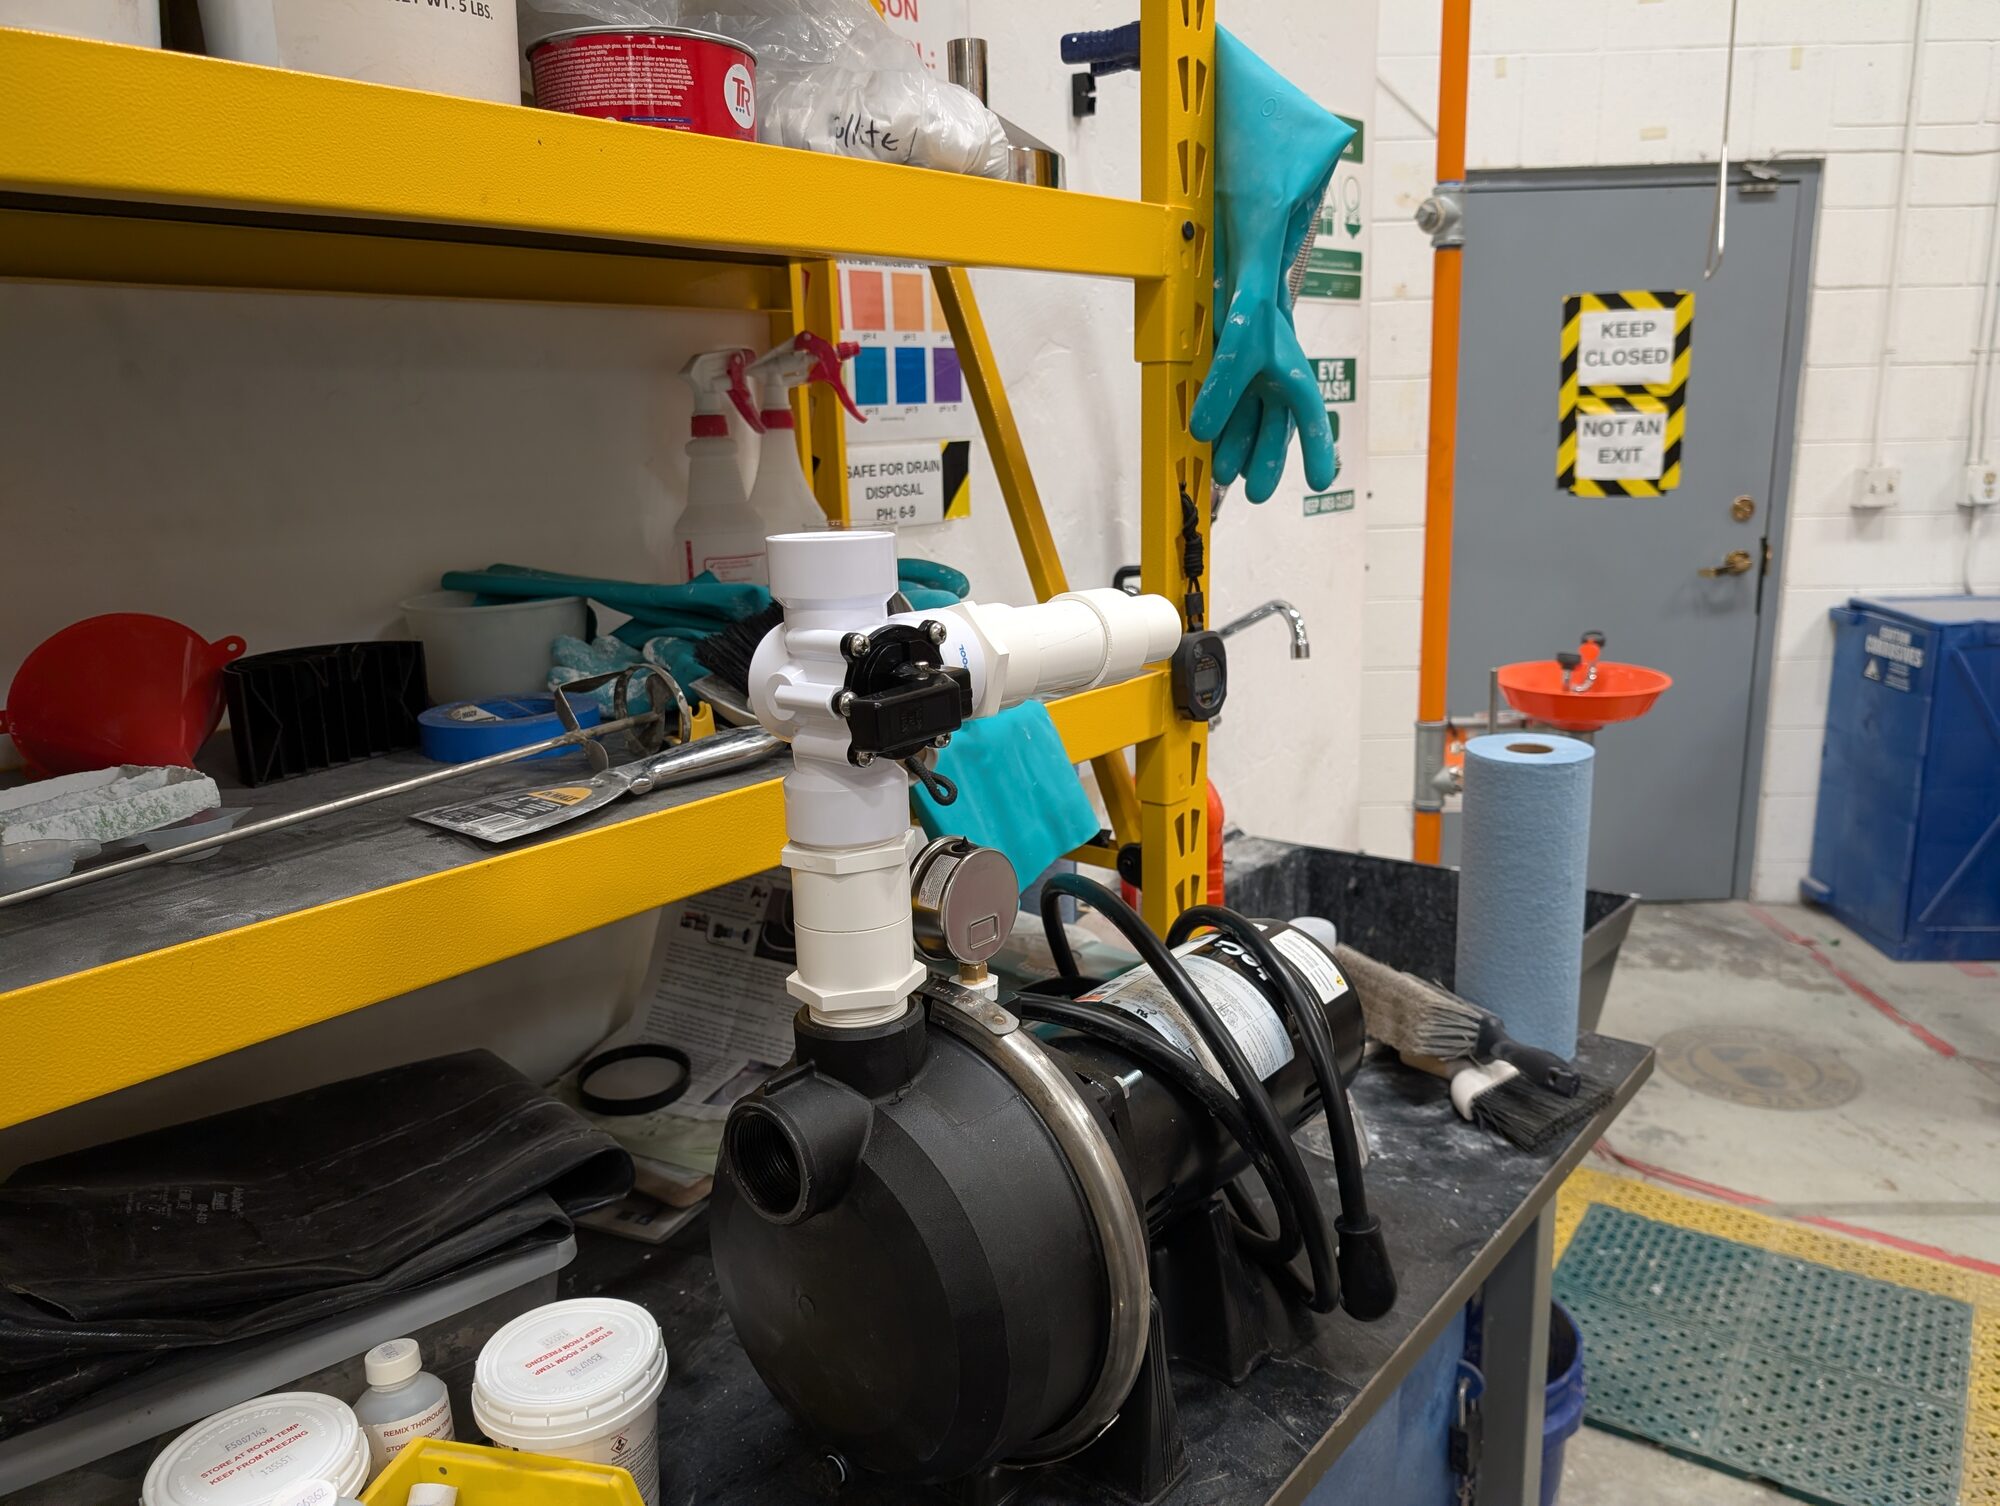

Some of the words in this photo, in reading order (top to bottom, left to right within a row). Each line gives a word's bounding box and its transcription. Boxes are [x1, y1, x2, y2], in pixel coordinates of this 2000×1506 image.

[470, 0, 494, 20] LBS.
[1601, 322, 1656, 339] KEEP
[1585, 349, 1669, 367] CLOSED
[1318, 361, 1345, 381] EYE
[1583, 420, 1626, 437] NOT
[1633, 420, 1661, 436] AN
[1597, 447, 1643, 464] EXIT
[847, 464, 877, 479] SAFE
[880, 463, 904, 477] FOR
[907, 460, 940, 475] DRAIN
[866, 483, 924, 500] DISPOSAL
[877, 508, 896, 521] PH:
[899, 505, 916, 518] 6-9
[585, 1325, 604, 1341] KEEP
[590, 1330, 613, 1345] STORE
[562, 1337, 585, 1351] FROM
[579, 1343, 590, 1352] AT
[525, 1347, 562, 1368] FREEZING
[554, 1350, 579, 1365] ROOM
[383, 1425, 409, 1438] REMIX
[201, 1459, 233, 1480] STORE
[234, 1452, 246, 1462] AT
[246, 1437, 275, 1455] ROOM
[209, 1469, 235, 1486] KEEP
[236, 1454, 264, 1471] FROM
[265, 1430, 309, 1457] FREEZING
